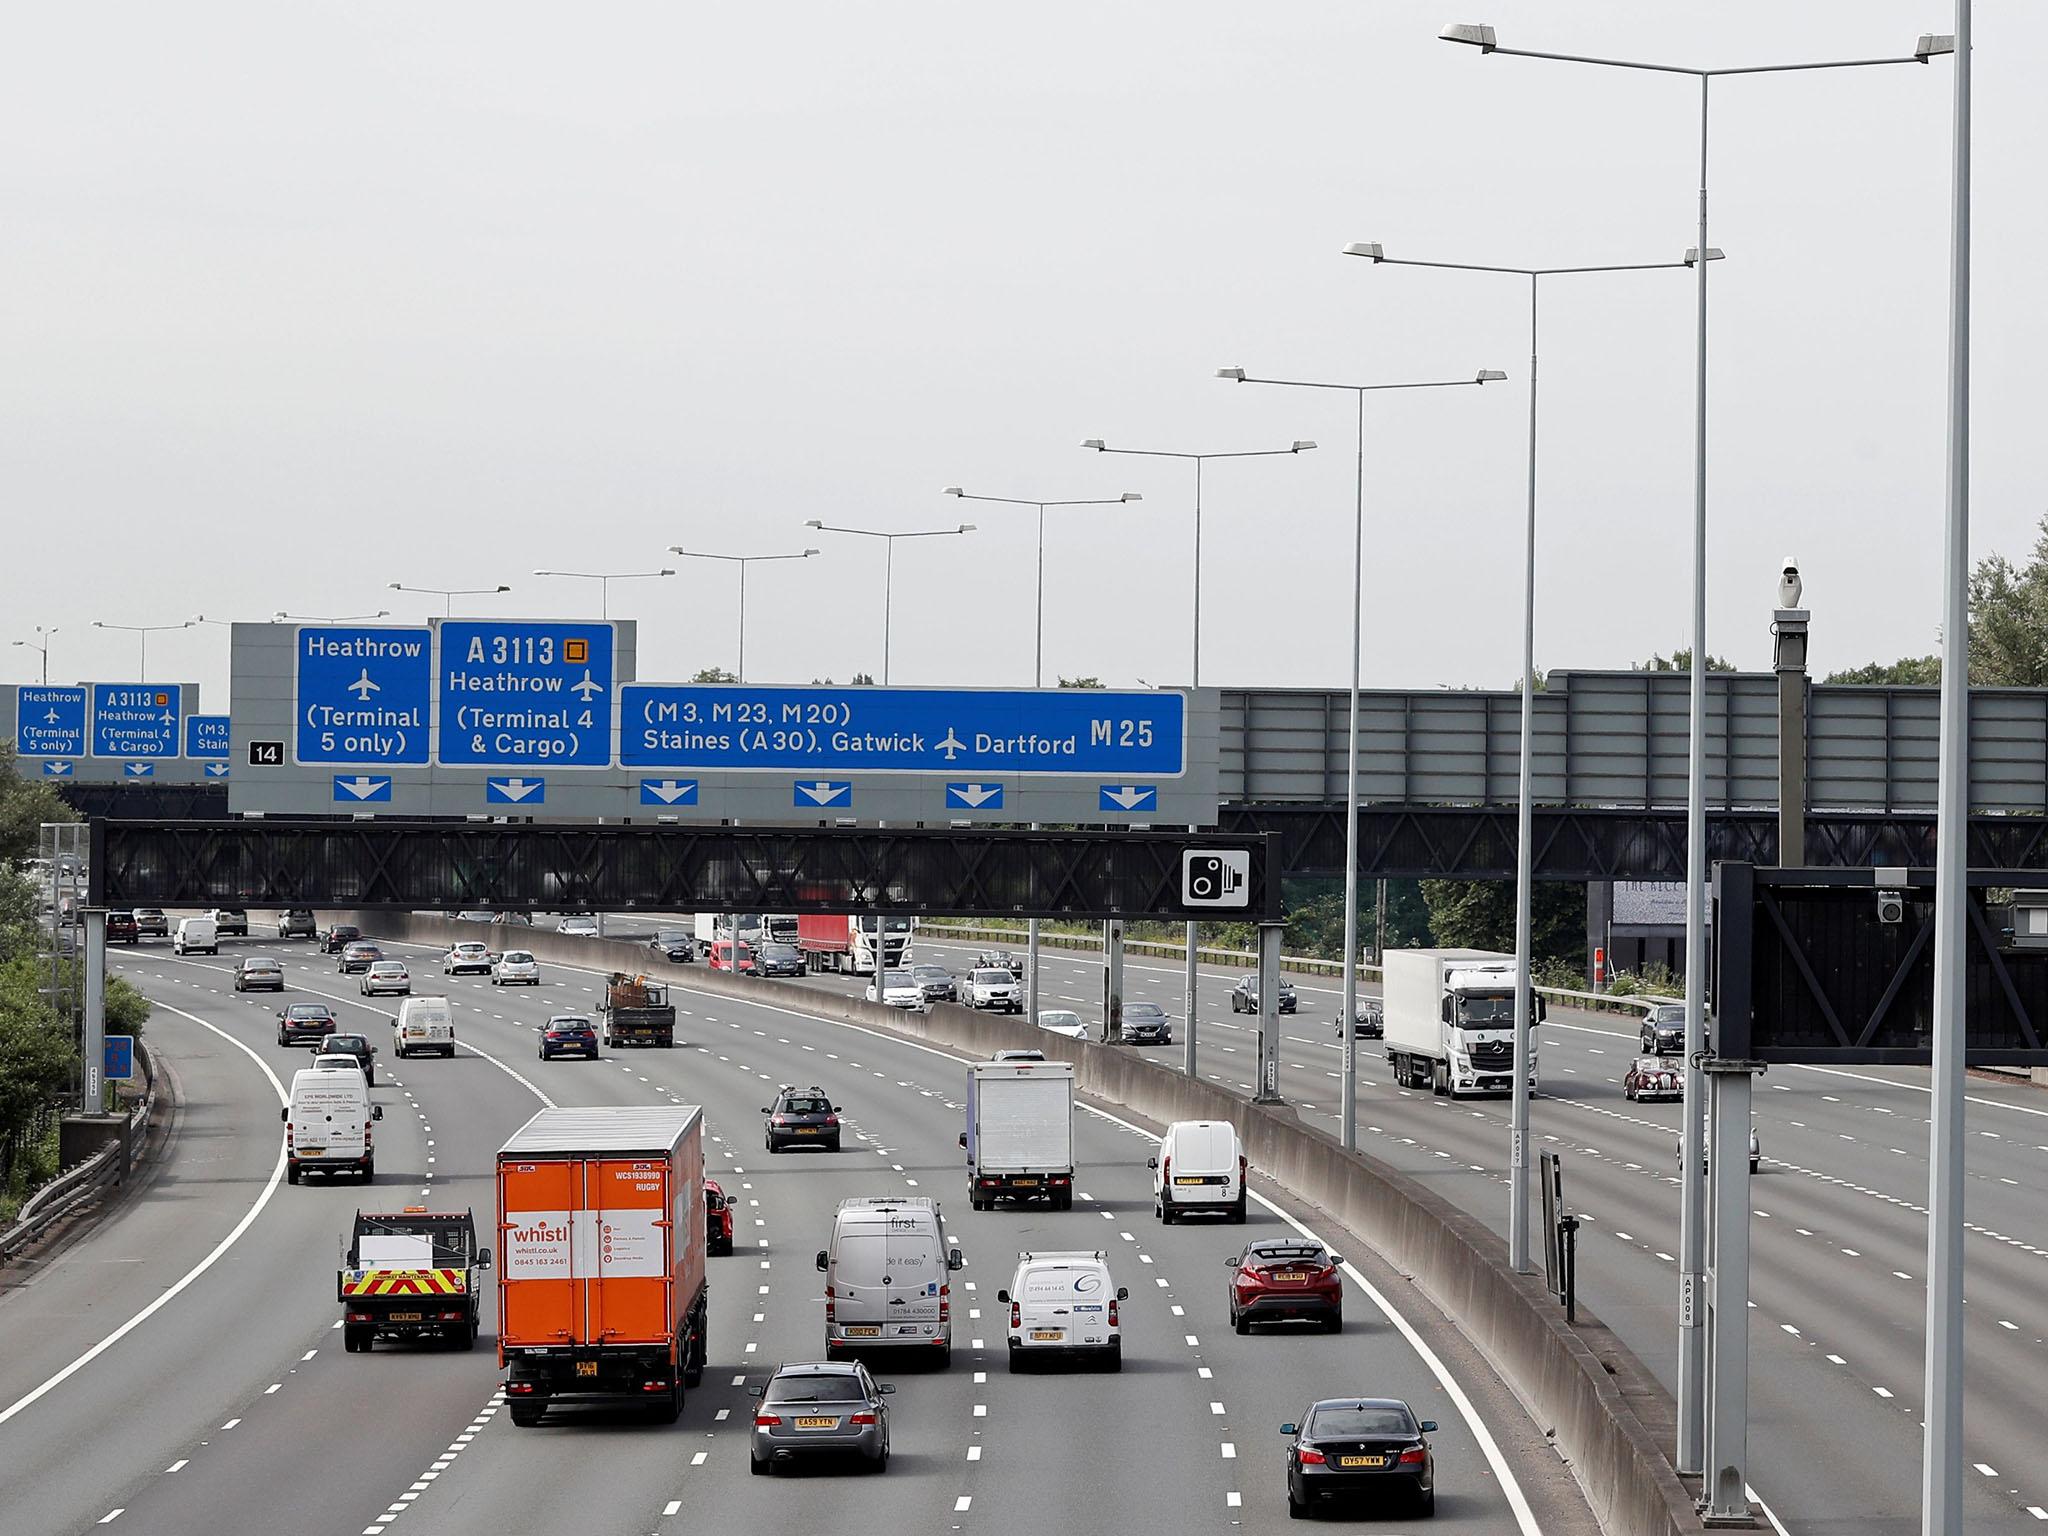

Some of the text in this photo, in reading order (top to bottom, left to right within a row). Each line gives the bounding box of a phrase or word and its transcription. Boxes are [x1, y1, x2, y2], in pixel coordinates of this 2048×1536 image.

[308, 637, 421, 657] Heathrow
[450, 671, 563, 692] Heathrow
[24, 692, 81, 703] Heathrow
[98, 710, 156, 722] Heathrow
[307, 704, 420, 728] (Terminal
[457, 706, 593, 730] (Terminal 4
[23, 726, 80, 738] (Terminal
[101, 727, 171, 740] (Terminal 4
[644, 729, 730, 750] Staines
[832, 732, 925, 752] Gatwick
[30, 740, 37, 750] 5
[108, 742, 117, 752] &
[321, 731, 407, 756] 5 only)
[471, 732, 579, 757] & Cargo)
[975, 733, 1075, 755] Dartford
[256, 747, 277, 762] 14
[636, 1183, 660, 1191] RUGBY
[514, 1221, 567, 1242] whistl
[891, 1217, 915, 1229] first
